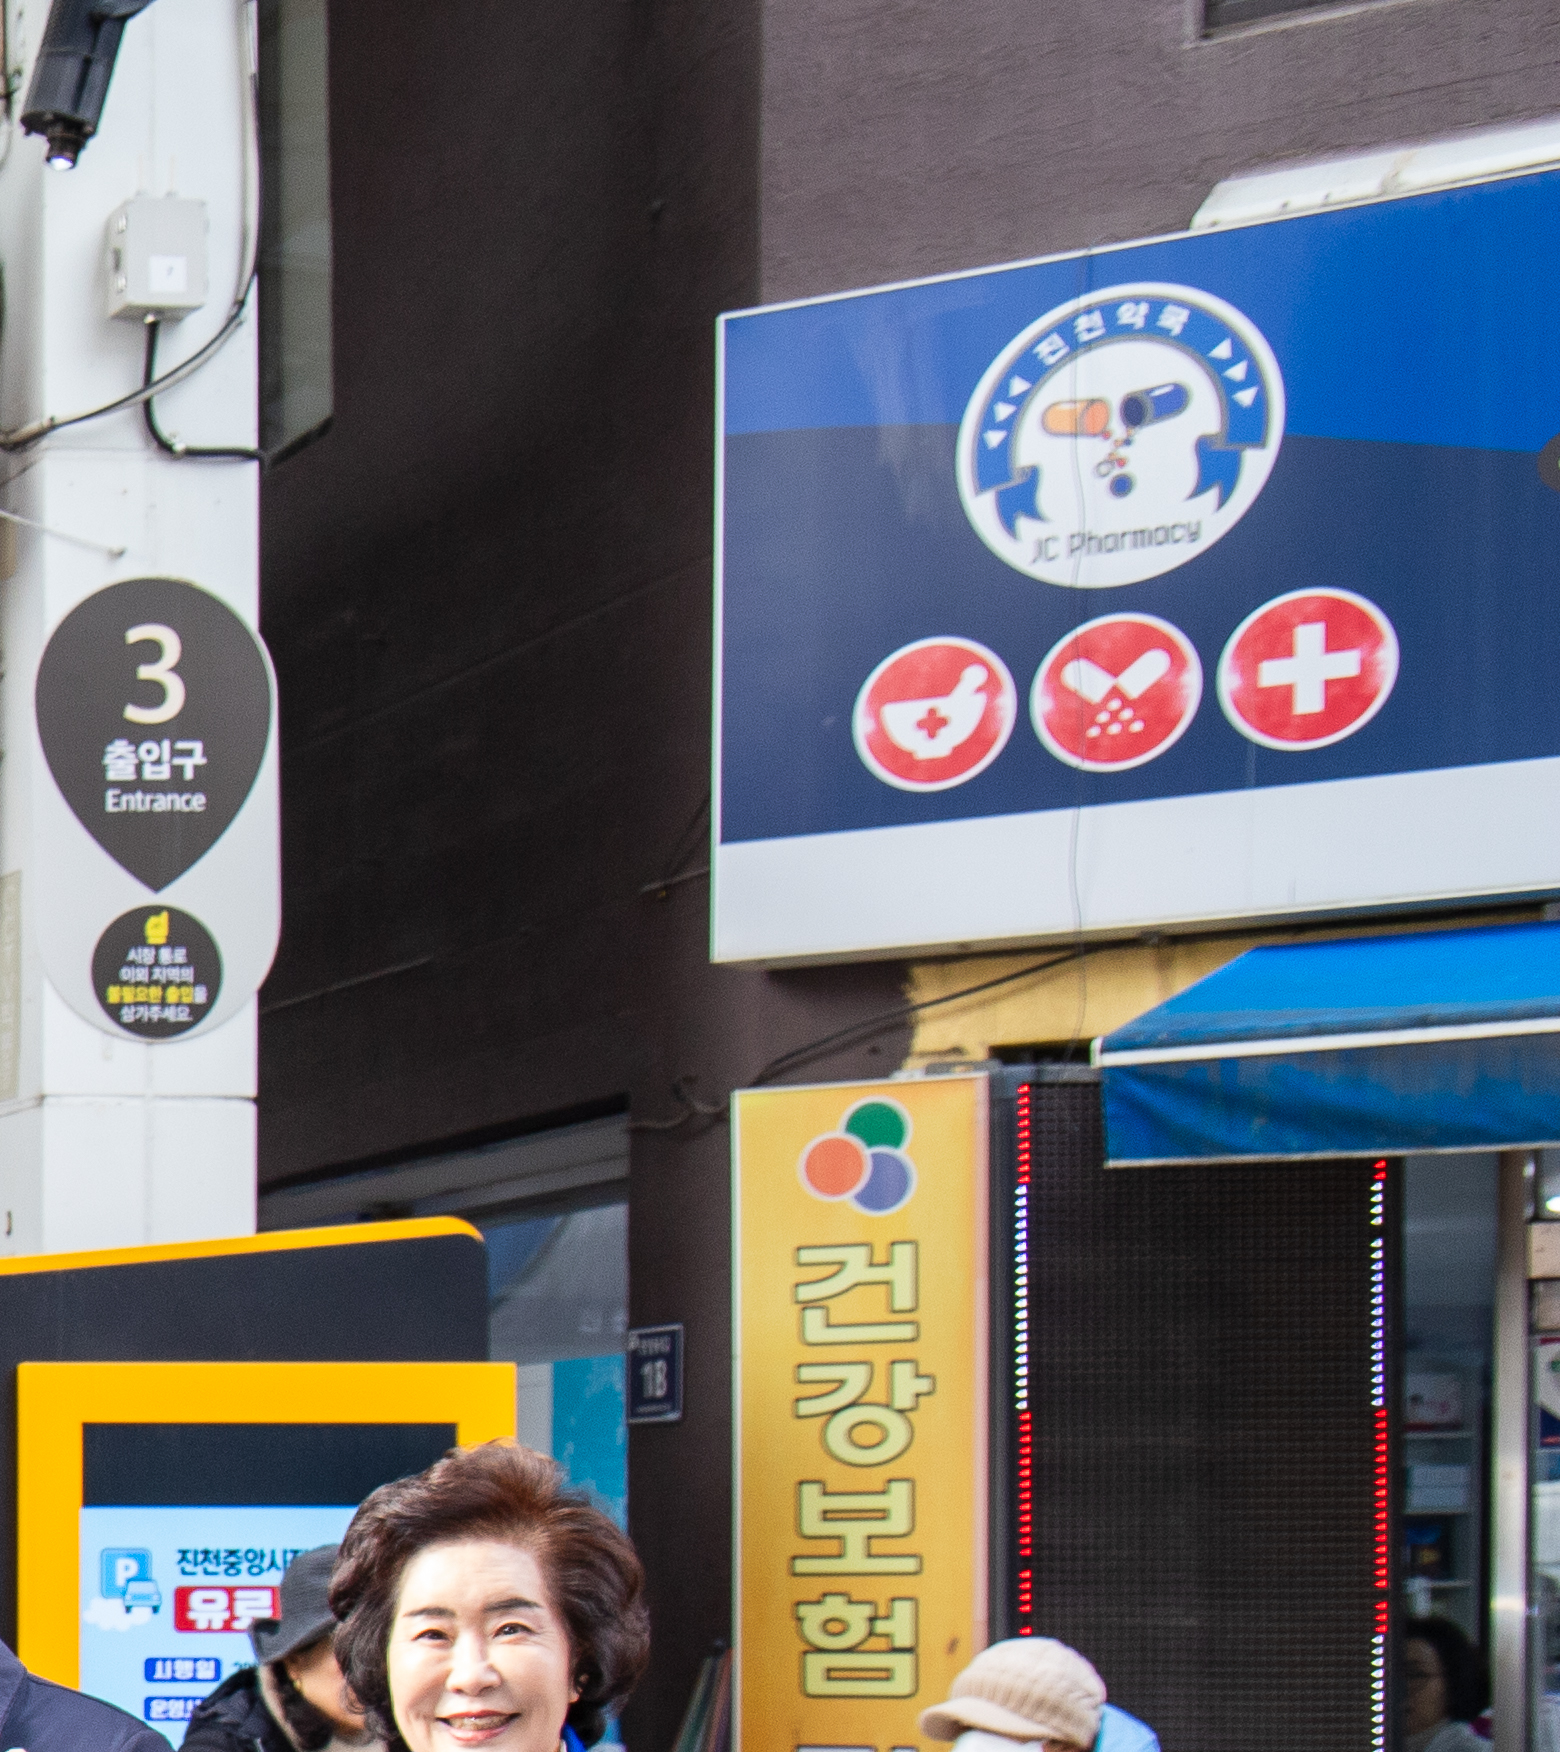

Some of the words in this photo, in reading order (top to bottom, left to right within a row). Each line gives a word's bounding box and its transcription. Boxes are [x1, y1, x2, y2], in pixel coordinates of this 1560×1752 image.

[1033, 302, 1188, 366] 진천약국
[1032, 533, 1060, 564] JC
[1067, 518, 1202, 558] Pharmacy
[123, 622, 187, 725] 3
[103, 739, 208, 783] 출입구
[105, 788, 207, 814] Entrance
[120, 965, 149, 984] 이외
[151, 965, 195, 985] 지역의
[126, 946, 156, 966] 시장
[158, 946, 188, 966] 통로
[791, 1241, 935, 1699] 건강보험
[154, 1660, 216, 1681] 시행일
